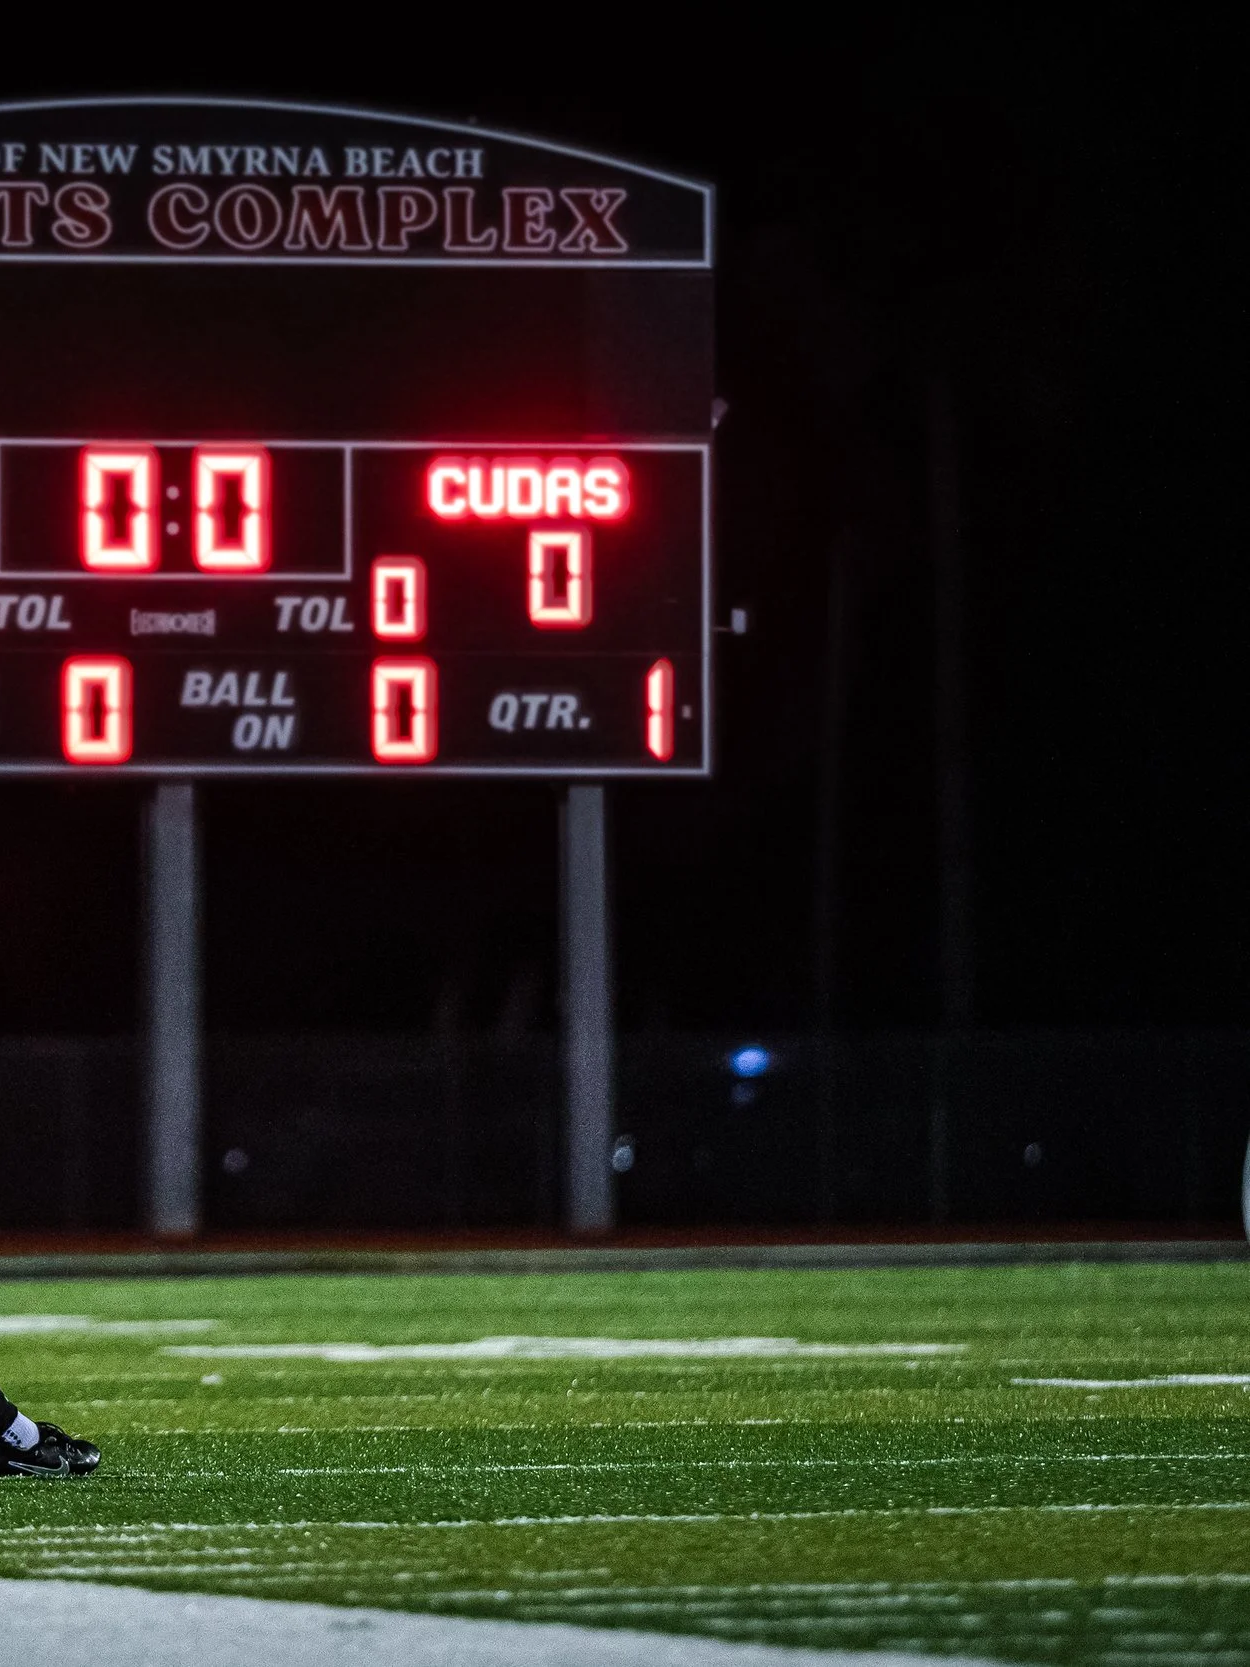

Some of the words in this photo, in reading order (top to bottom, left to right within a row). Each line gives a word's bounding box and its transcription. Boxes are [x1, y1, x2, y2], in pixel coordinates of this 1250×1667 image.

[39, 142, 138, 174] NEW
[152, 144, 332, 176] SMYRNA
[344, 147, 484, 178] BEACH
[147, 183, 630, 254] COMPLEX
[426, 464, 626, 519] CUDAS
[372, 565, 418, 636] 0
[527, 529, 584, 624] 0
[274, 596, 355, 632] TOL
[62, 662, 124, 761] 0
[180, 671, 296, 707] BALL
[372, 664, 429, 760] 0
[487, 693, 592, 730] QTR.
[646, 662, 670, 761] 1
[231, 714, 296, 750] ON
